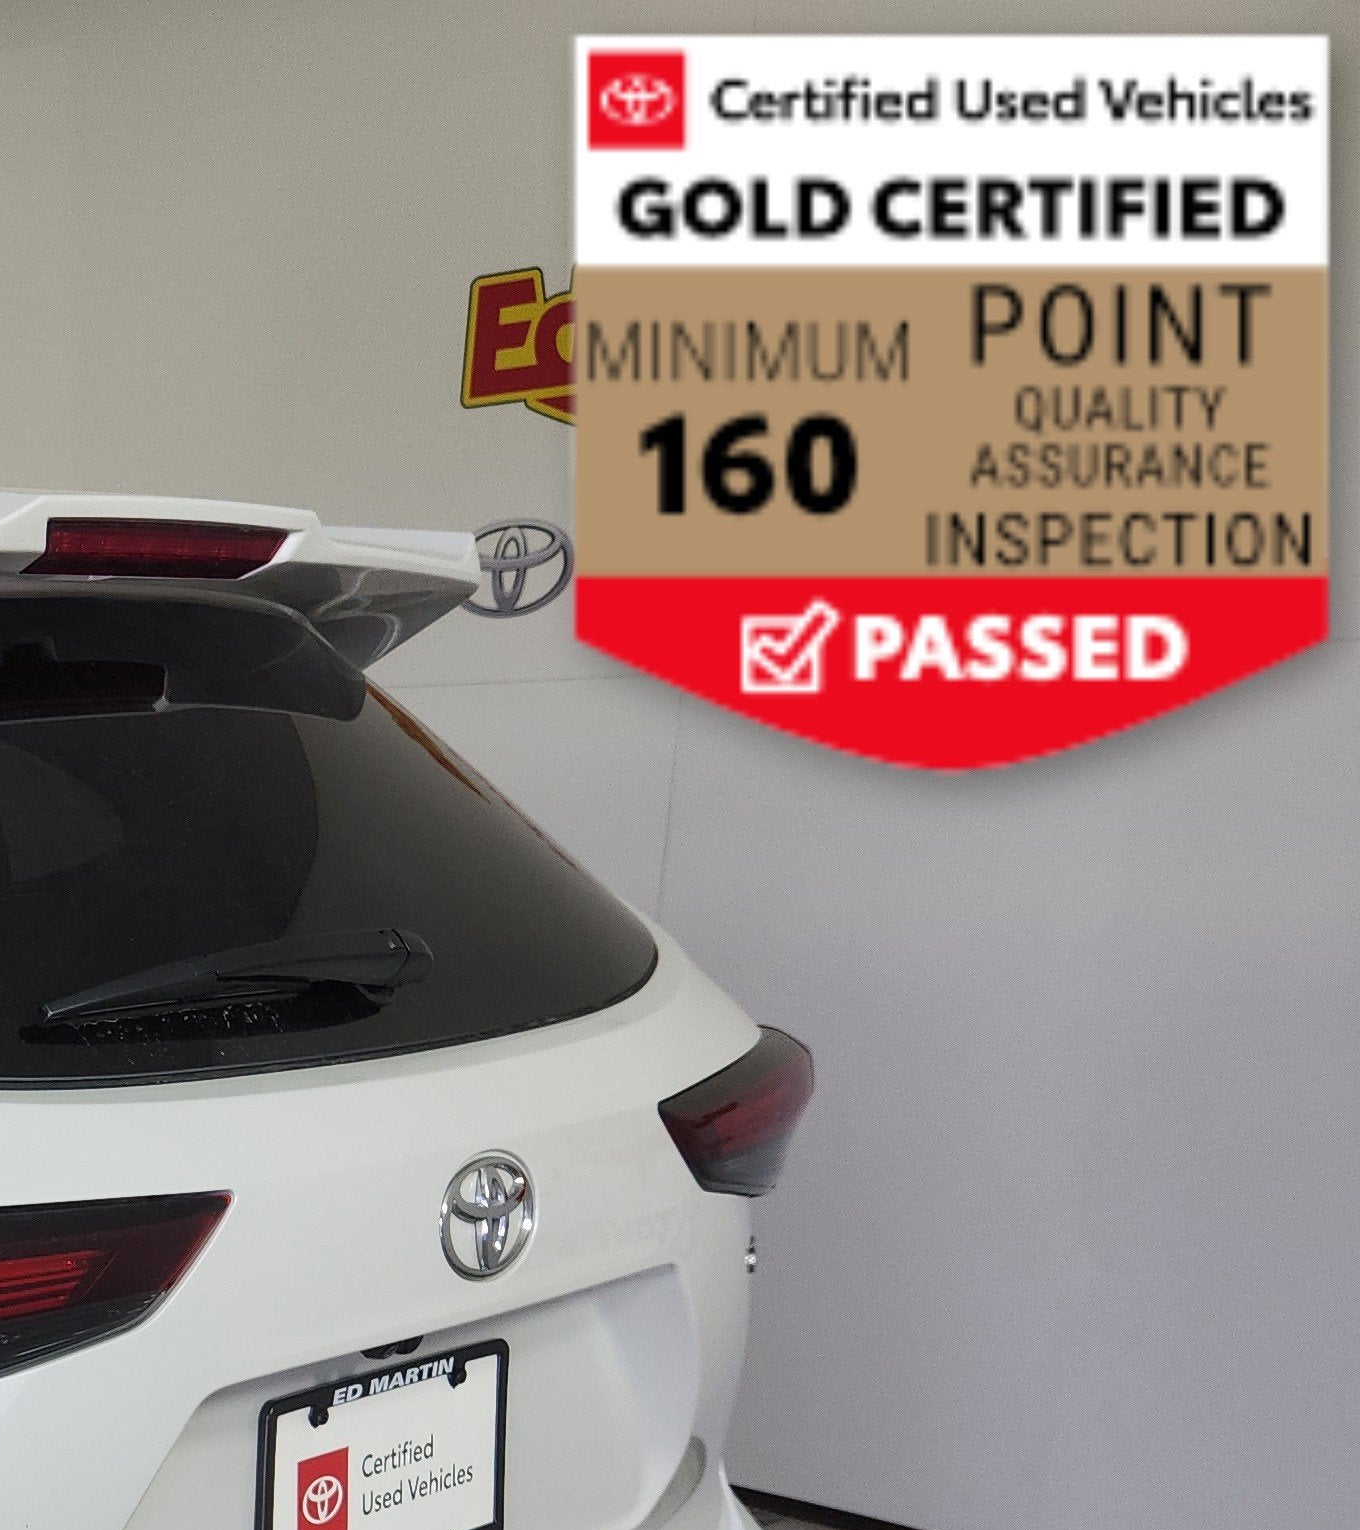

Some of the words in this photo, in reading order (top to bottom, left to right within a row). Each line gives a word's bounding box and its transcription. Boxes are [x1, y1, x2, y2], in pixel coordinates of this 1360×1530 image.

[332, 1384, 363, 1405] ED
[369, 1356, 455, 1395] MARTIN
[361, 1434, 434, 1478] Certified
[362, 1480, 403, 1516] Used
[407, 1464, 474, 1501] Vehicles
